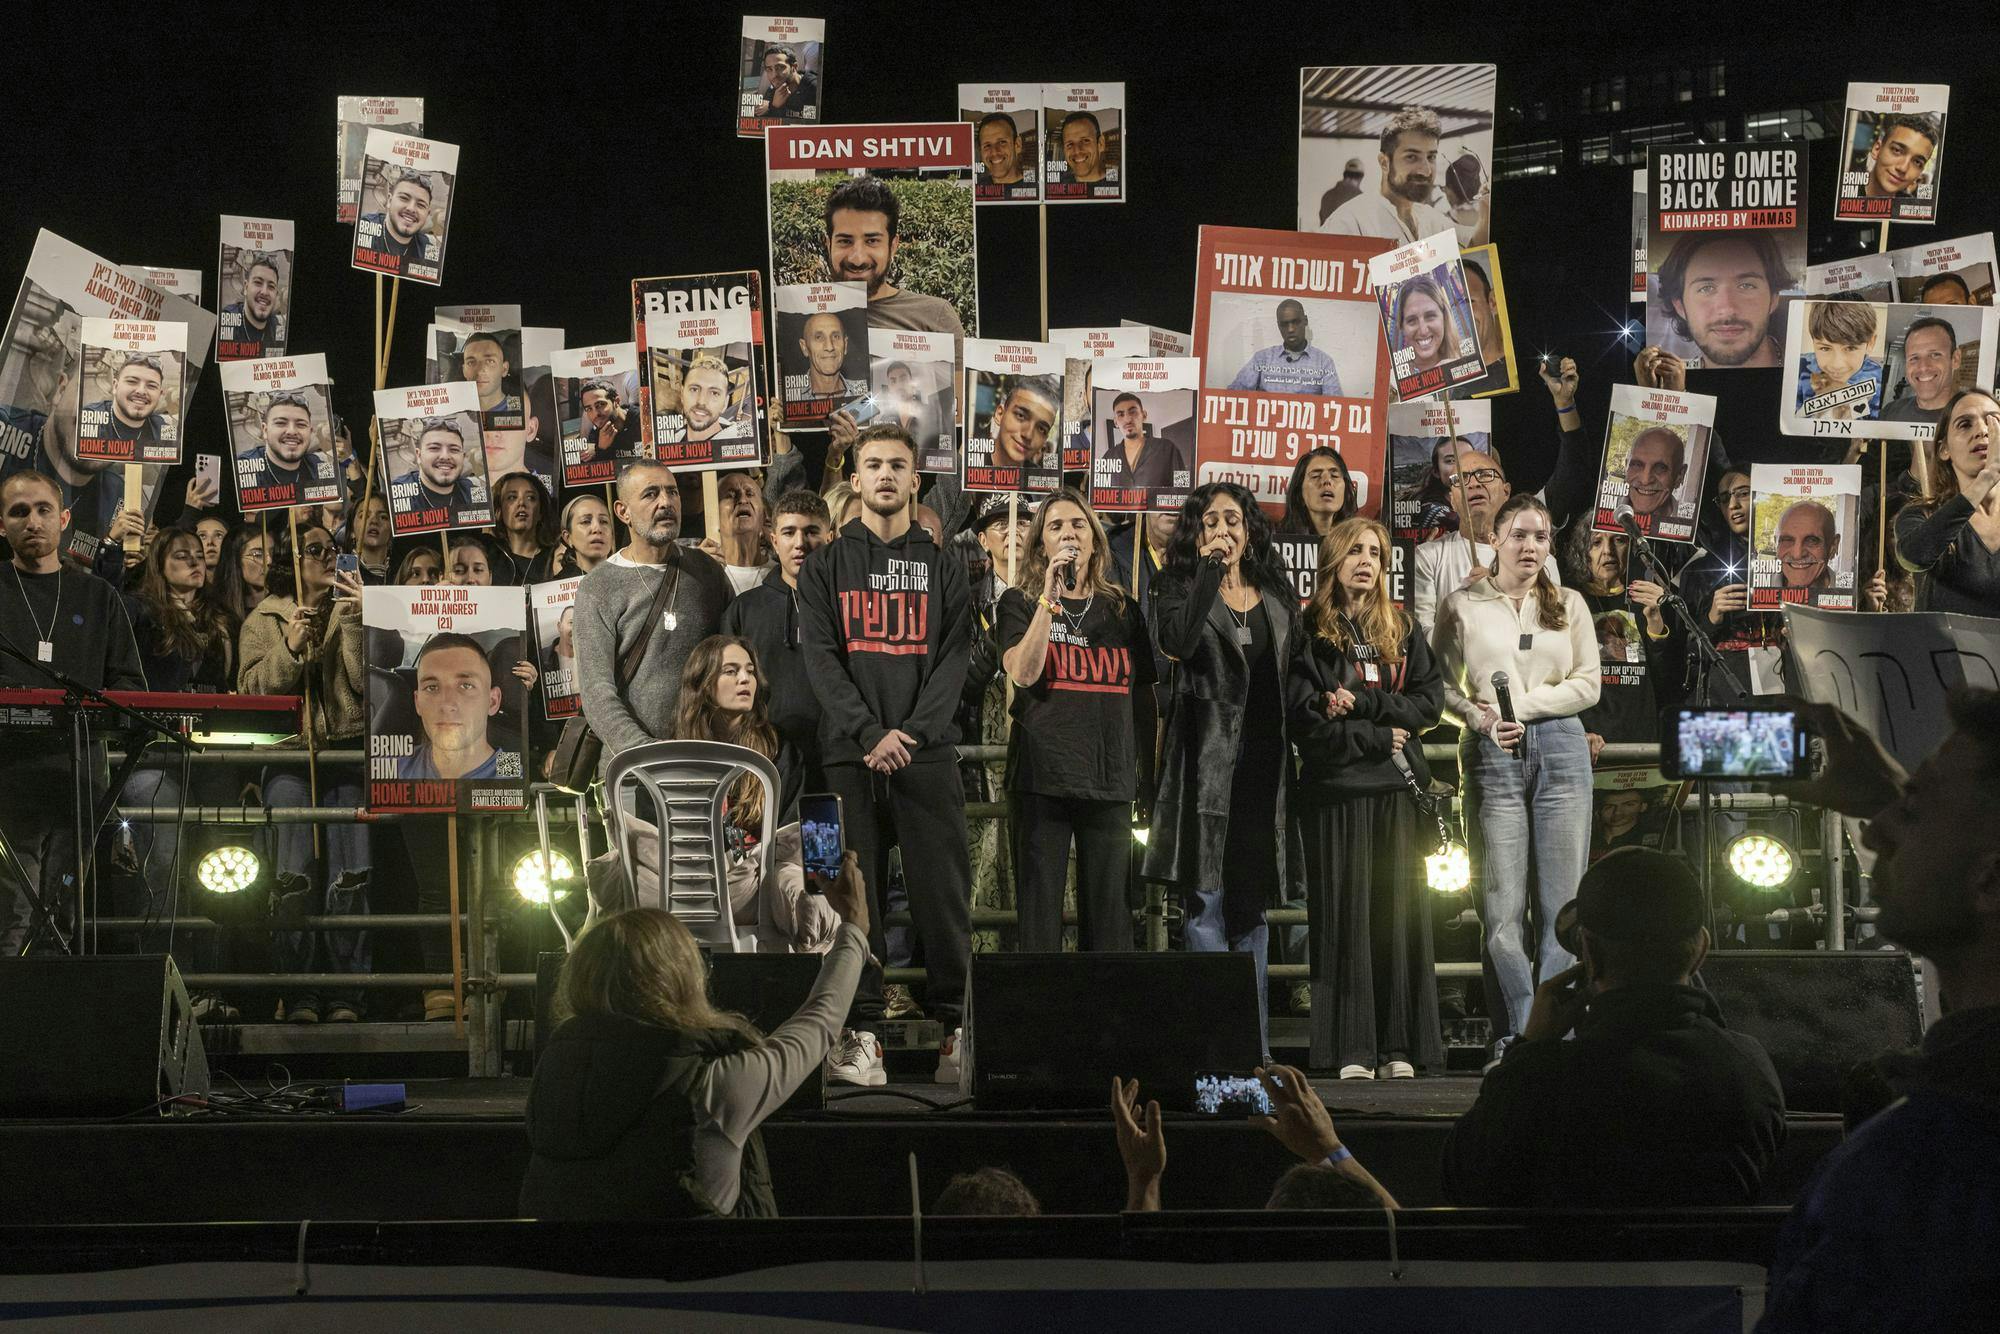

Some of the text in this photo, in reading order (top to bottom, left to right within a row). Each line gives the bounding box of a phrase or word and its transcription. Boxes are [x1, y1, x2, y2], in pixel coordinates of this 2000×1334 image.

[742, 94, 763, 106] BRING
[1890, 95, 1919, 103] ALEXANDER
[741, 106, 755, 117] HIM
[741, 118, 759, 130] HOME
[789, 137, 952, 159] IDAN SHTIVI
[408, 150, 430, 161] MEIR JAN
[1047, 161, 1068, 172] BRING
[1660, 150, 1797, 181] BRING OMER
[1047, 173, 1061, 183] HIM
[1843, 172, 1869, 185] BRING
[1046, 184, 1066, 195] HOME
[1067, 183, 1087, 195] NOW!
[1660, 179, 1797, 210] BACK HOME
[1841, 185, 1858, 198] HIM
[340, 192, 355, 204] HIM
[1840, 200, 1864, 212] HOME
[1866, 199, 1892, 212] NOW!
[1664, 211, 1792, 228] KIDNAPPED BY HAMAS
[359, 220, 382, 237] BRING
[357, 234, 373, 249] HIM
[356, 249, 400, 269] HOME NOW!
[1214, 252, 1264, 288] אותי
[1271, 256, 1343, 294] תשכחו
[114, 272, 136, 295] מאיר
[84, 279, 119, 305] ALMOG
[118, 295, 143, 319] MEIR
[135, 282, 165, 310] אלמוג
[643, 285, 750, 317] BRING
[818, 294, 836, 302] YAAKOV
[221, 312, 242, 327] BRING
[113, 331, 157, 341] ALMOG MEIR JAN
[220, 327, 234, 341] HIM
[678, 326, 719, 338] ELKANA BOHBOT
[219, 342, 239, 355] HOME
[240, 341, 260, 355] NOW!
[694, 337, 705, 346] (34)
[1083, 341, 1115, 349] TAL SHOHAM
[599, 357, 615, 367] COHEN
[994, 354, 1038, 364] EDAN ALEXANDER
[1393, 346, 1416, 366] BRING
[253, 369, 297, 381] ALMOG MEIR JAN
[1122, 371, 1168, 380] ROM BRASLAVSKI
[1396, 363, 1412, 380] HER
[270, 380, 281, 389] (21)
[785, 375, 810, 388] BRING
[1400, 373, 1422, 394] HOME
[1422, 367, 1445, 388] NOW!
[407, 396, 450, 408] ALMOG MEIR JAN
[785, 388, 801, 402] HIM
[1806, 382, 1873, 412] מחכה לאבא
[786, 400, 834, 416] HOME NOW!
[1203, 395, 1372, 434] גם לי מחכים בבית
[1641, 401, 1689, 414] SHLOMO MANTZUR
[81, 410, 110, 425] BRING
[656, 415, 684, 430] BRING
[1421, 419, 1432, 427] NOA
[80, 424, 99, 438] HIM
[1813, 421, 1852, 435] איתן
[658, 429, 676, 444] HIM
[1232, 429, 1277, 458] שנים
[79, 439, 106, 453] HOME
[107, 440, 135, 457] NOW!
[563, 437, 589, 453] BRING
[658, 444, 685, 460] HOME
[686, 441, 713, 458] NOW!
[968, 439, 995, 453] BRING
[1286, 433, 1299, 460] 9
[565, 451, 581, 465] HIM
[968, 453, 985, 467] HIM
[237, 458, 265, 474] BRING
[566, 461, 615, 480] HOME NOW!
[1095, 459, 1122, 473] BRING
[239, 474, 258, 488] HIM
[967, 469, 993, 484] HOME
[994, 469, 1020, 485] NOW!
[1095, 473, 1112, 487] HIM
[1783, 477, 1833, 485] SHLOMO MANTZUR
[391, 482, 419, 499] BRING
[1267, 475, 1289, 495] את
[1602, 480, 1629, 496] BRING
[241, 485, 268, 503] HOME
[269, 483, 296, 500] NOW!
[1094, 489, 1120, 504] HOME
[1121, 488, 1147, 504] NOW!
[393, 498, 411, 513] HIM
[1394, 501, 1421, 514] BRING
[1600, 494, 1618, 509] HIM
[395, 510, 422, 528] HOME
[422, 507, 449, 525] NOW!
[1394, 515, 1412, 528] HER
[888, 558, 928, 577] מחזירים
[1753, 560, 1782, 573] BRING
[901, 575, 928, 592] אותם
[1753, 574, 1771, 587] HIM
[420, 589, 469, 602] מתן אנגרסט
[547, 596, 556, 605] ELI
[1752, 588, 1779, 603] HOME
[1781, 588, 1808, 603] NOW!
[411, 603, 478, 615] MATAN ANGREST
[839, 590, 928, 641] עכשיו
[437, 616, 453, 630] (21)
[1050, 633, 1089, 647] HEM HOME
[1046, 642, 1130, 686] NOW!
[1610, 666, 1645, 676] מחזירים את
[545, 669, 572, 685] BRING
[546, 684, 572, 699] THEM
[549, 698, 574, 712] HOME
[370, 734, 413, 757] BRING
[370, 757, 398, 780] HIM
[370, 782, 456, 805] HOME NOW!
[471, 795, 524, 807] FAMILIES FORUM
